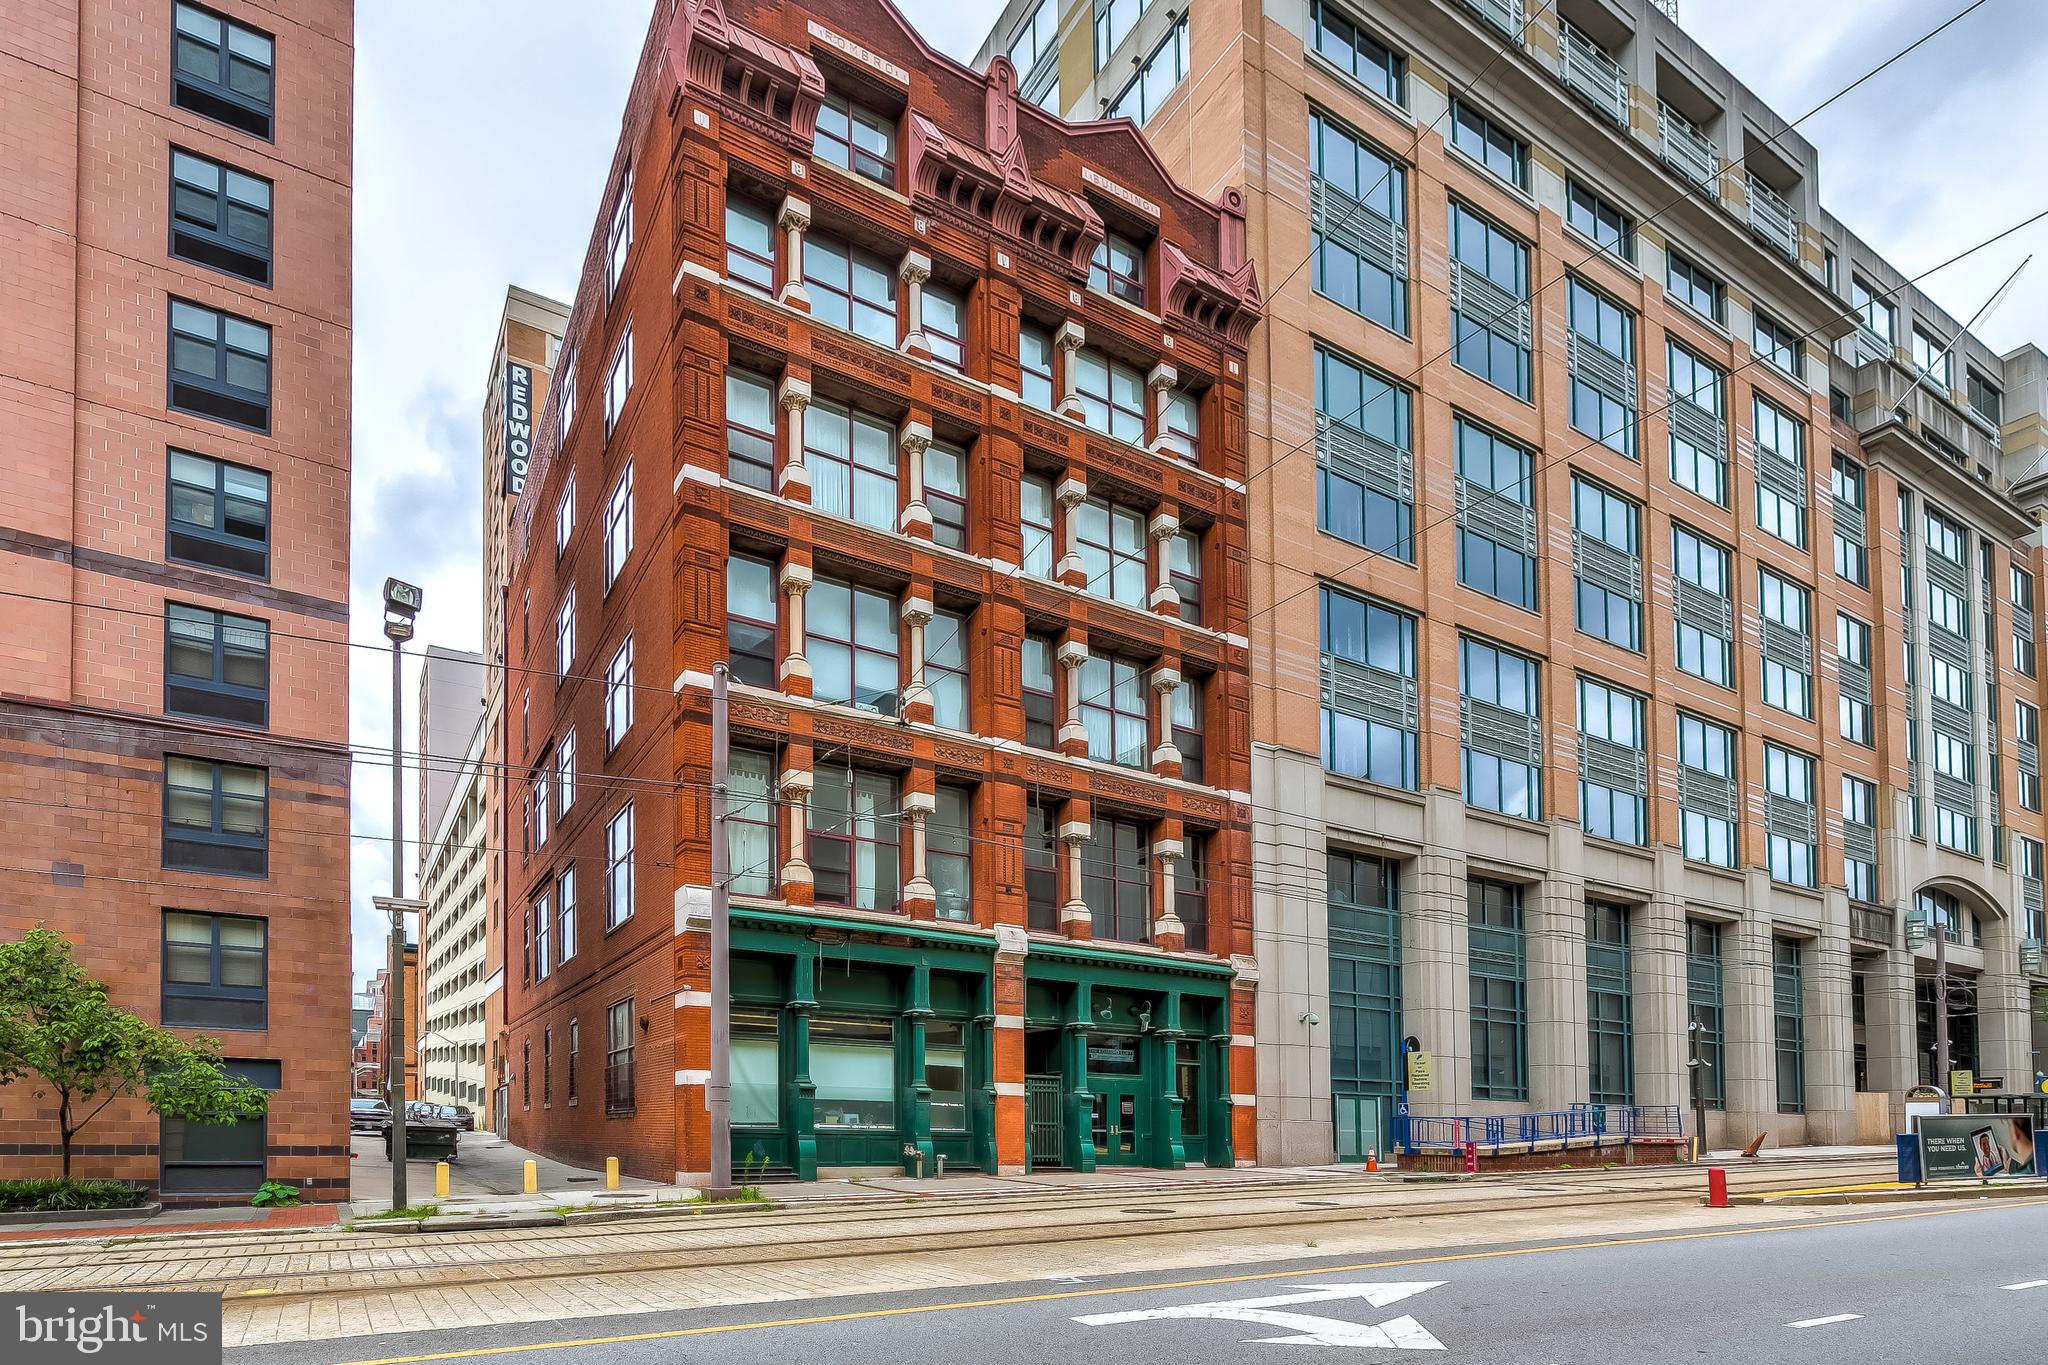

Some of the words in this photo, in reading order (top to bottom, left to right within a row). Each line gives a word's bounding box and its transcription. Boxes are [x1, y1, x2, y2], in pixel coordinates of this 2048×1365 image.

[1092, 174, 1150, 210] BUILDING
[508, 365, 531, 494] REDWOOD
[1927, 1137, 1946, 1145] THERE
[1927, 1145, 1940, 1153] YOU
